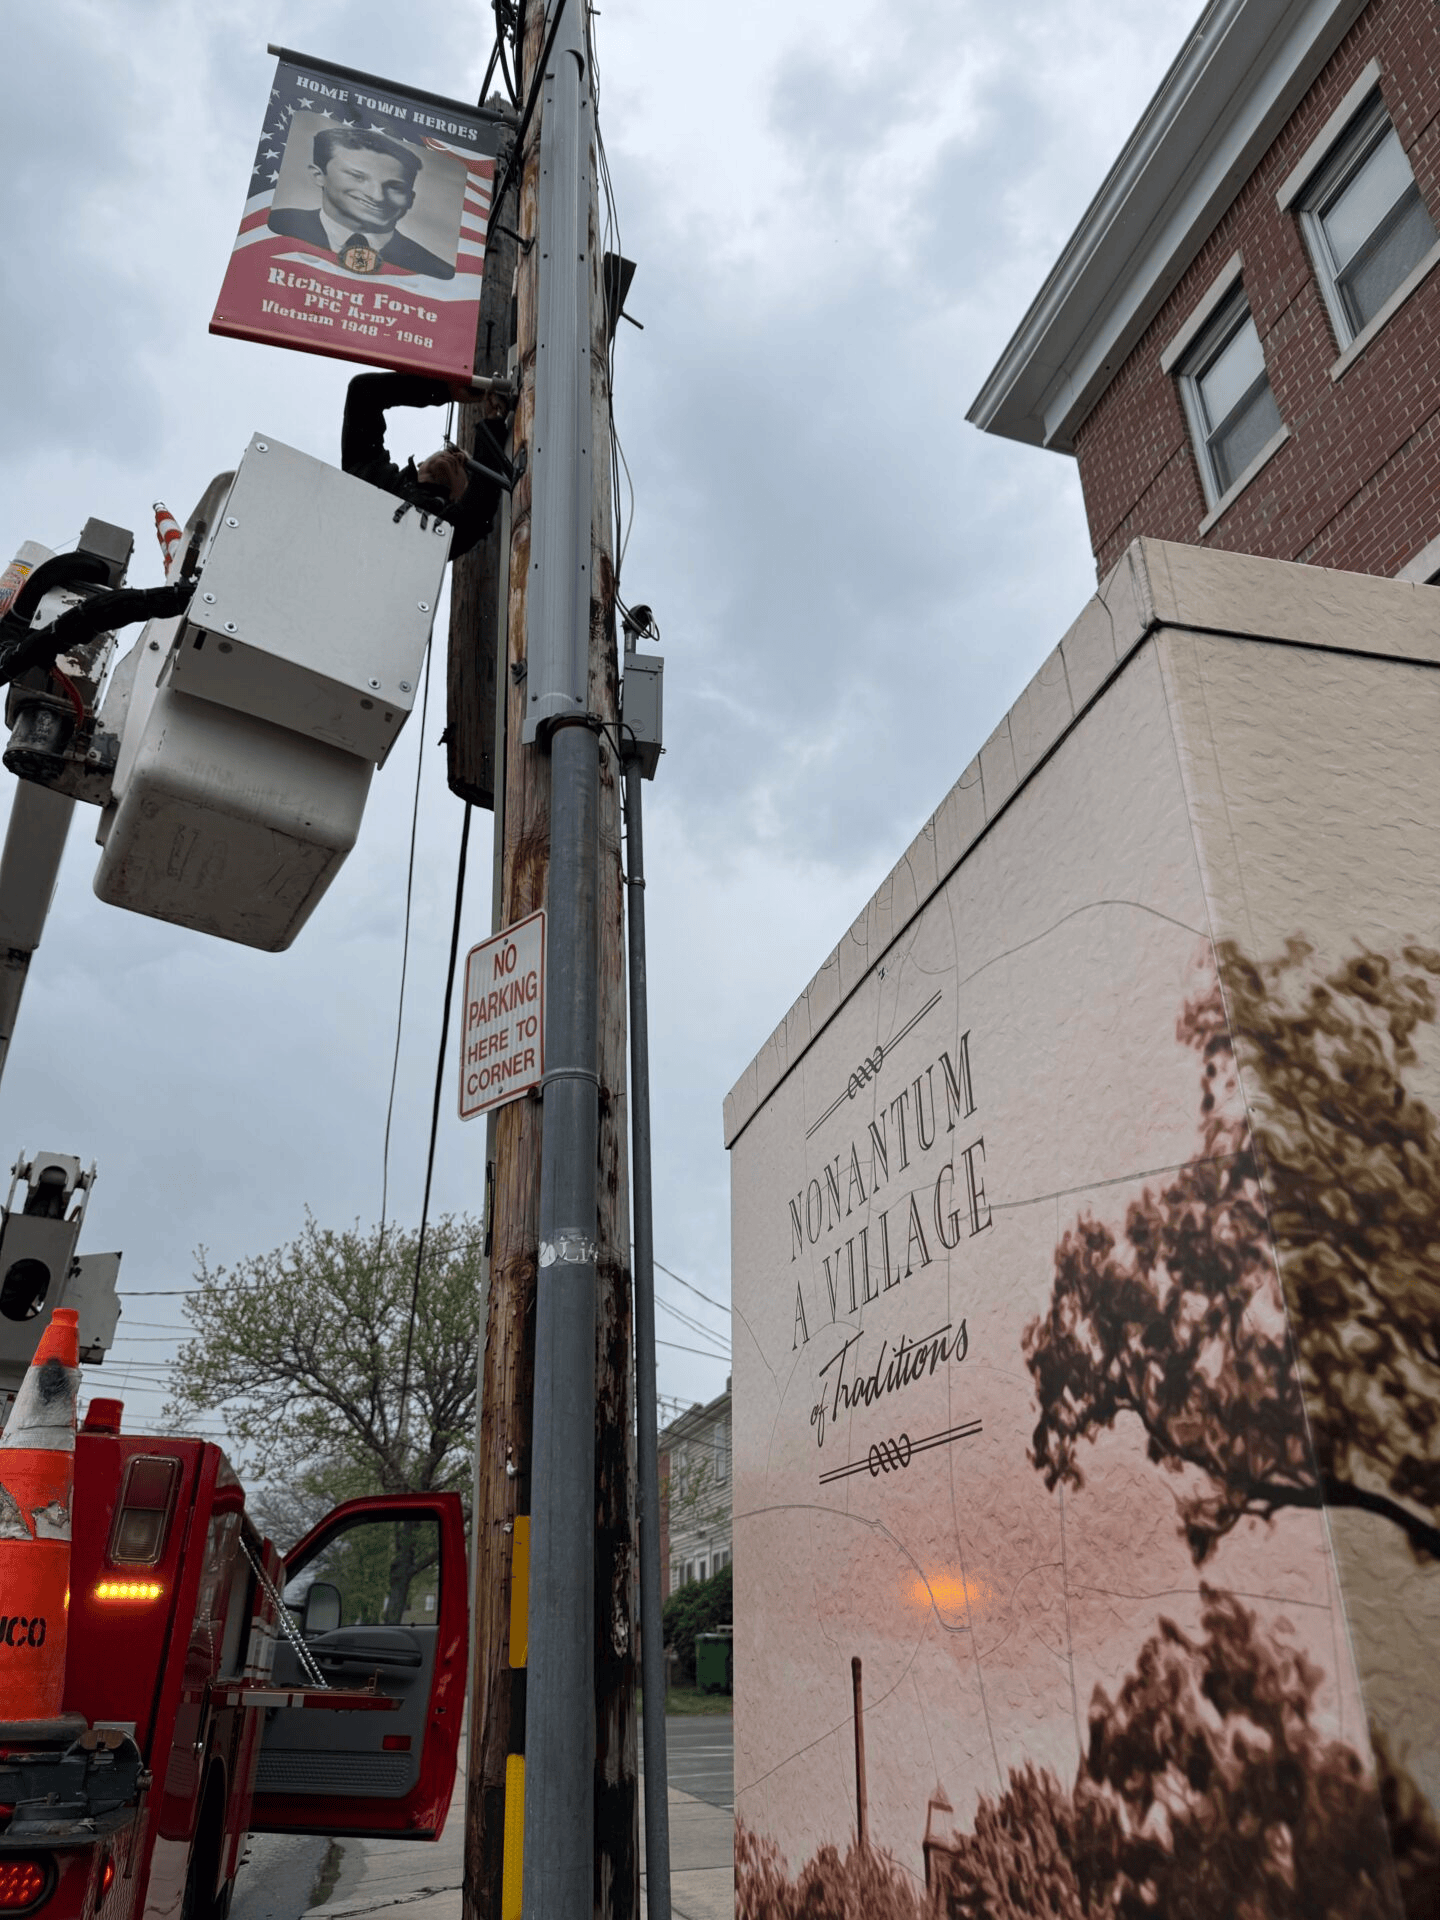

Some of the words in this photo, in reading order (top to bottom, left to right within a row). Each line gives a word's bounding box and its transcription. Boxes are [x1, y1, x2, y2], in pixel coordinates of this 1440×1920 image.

[296, 75, 349, 102] HOME
[354, 93, 407, 120] TOWN
[412, 111, 478, 141] HEROES
[261, 298, 334, 326] Vietnam
[341, 319, 378, 337] 1948
[396, 330, 433, 349] 1968
[267, 267, 364, 306] Richard
[373, 293, 438, 323] Forte
[304, 293, 342, 313] PFC
[347, 305, 398, 327] Army
[493, 944, 517, 981] NO
[468, 971, 538, 1031] PARKING
[467, 1028, 509, 1065] HERE
[516, 1015, 537, 1042] TO
[467, 1048, 535, 1096] CORNER
[788, 1029, 978, 1263] NONANTUM
[792, 1280, 810, 1351] A
[822, 1135, 993, 1324] VILLAGE
[819, 1318, 968, 1422] Traditions
[810, 1381, 829, 1448] of
